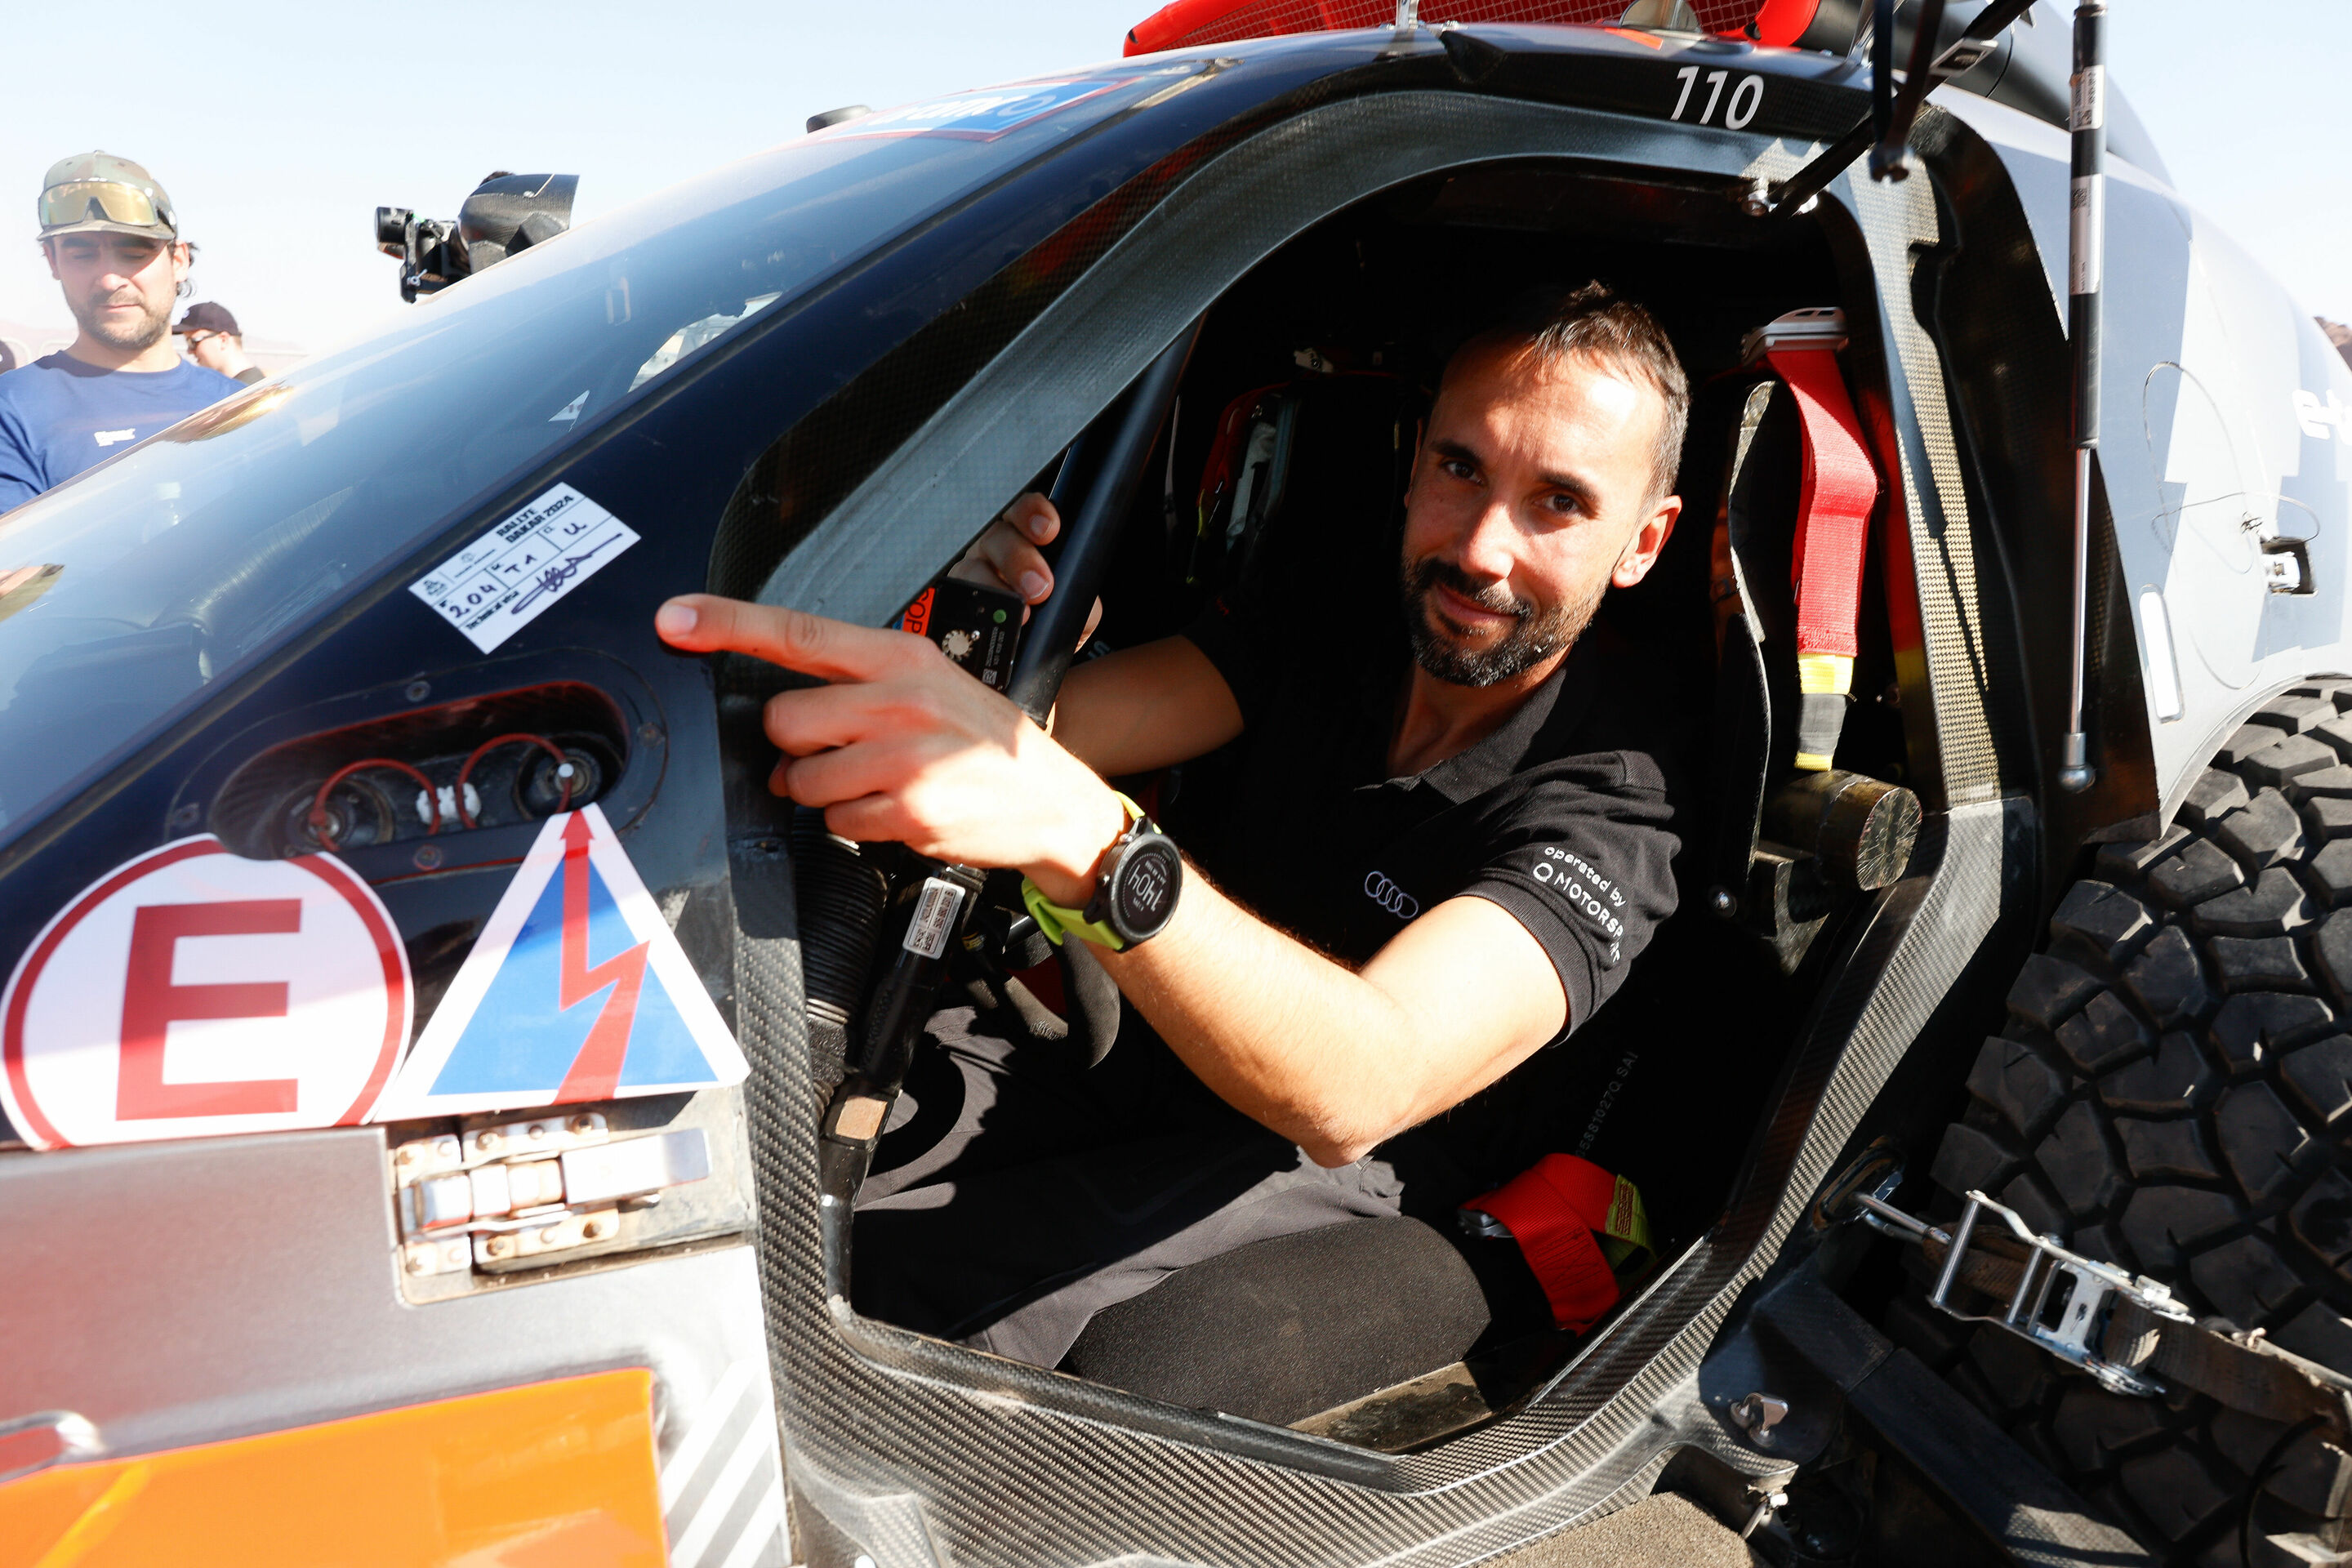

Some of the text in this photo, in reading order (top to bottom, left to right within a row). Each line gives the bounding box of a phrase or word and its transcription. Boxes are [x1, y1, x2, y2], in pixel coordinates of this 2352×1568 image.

[1670, 65, 1764, 131] 110
[496, 508, 537, 537] RALLYE
[505, 514, 546, 543] DAKAR
[1544, 846, 1626, 907] operated by
[1554, 871, 1624, 964] MOTORSPRT
[116, 898, 303, 1121] E
